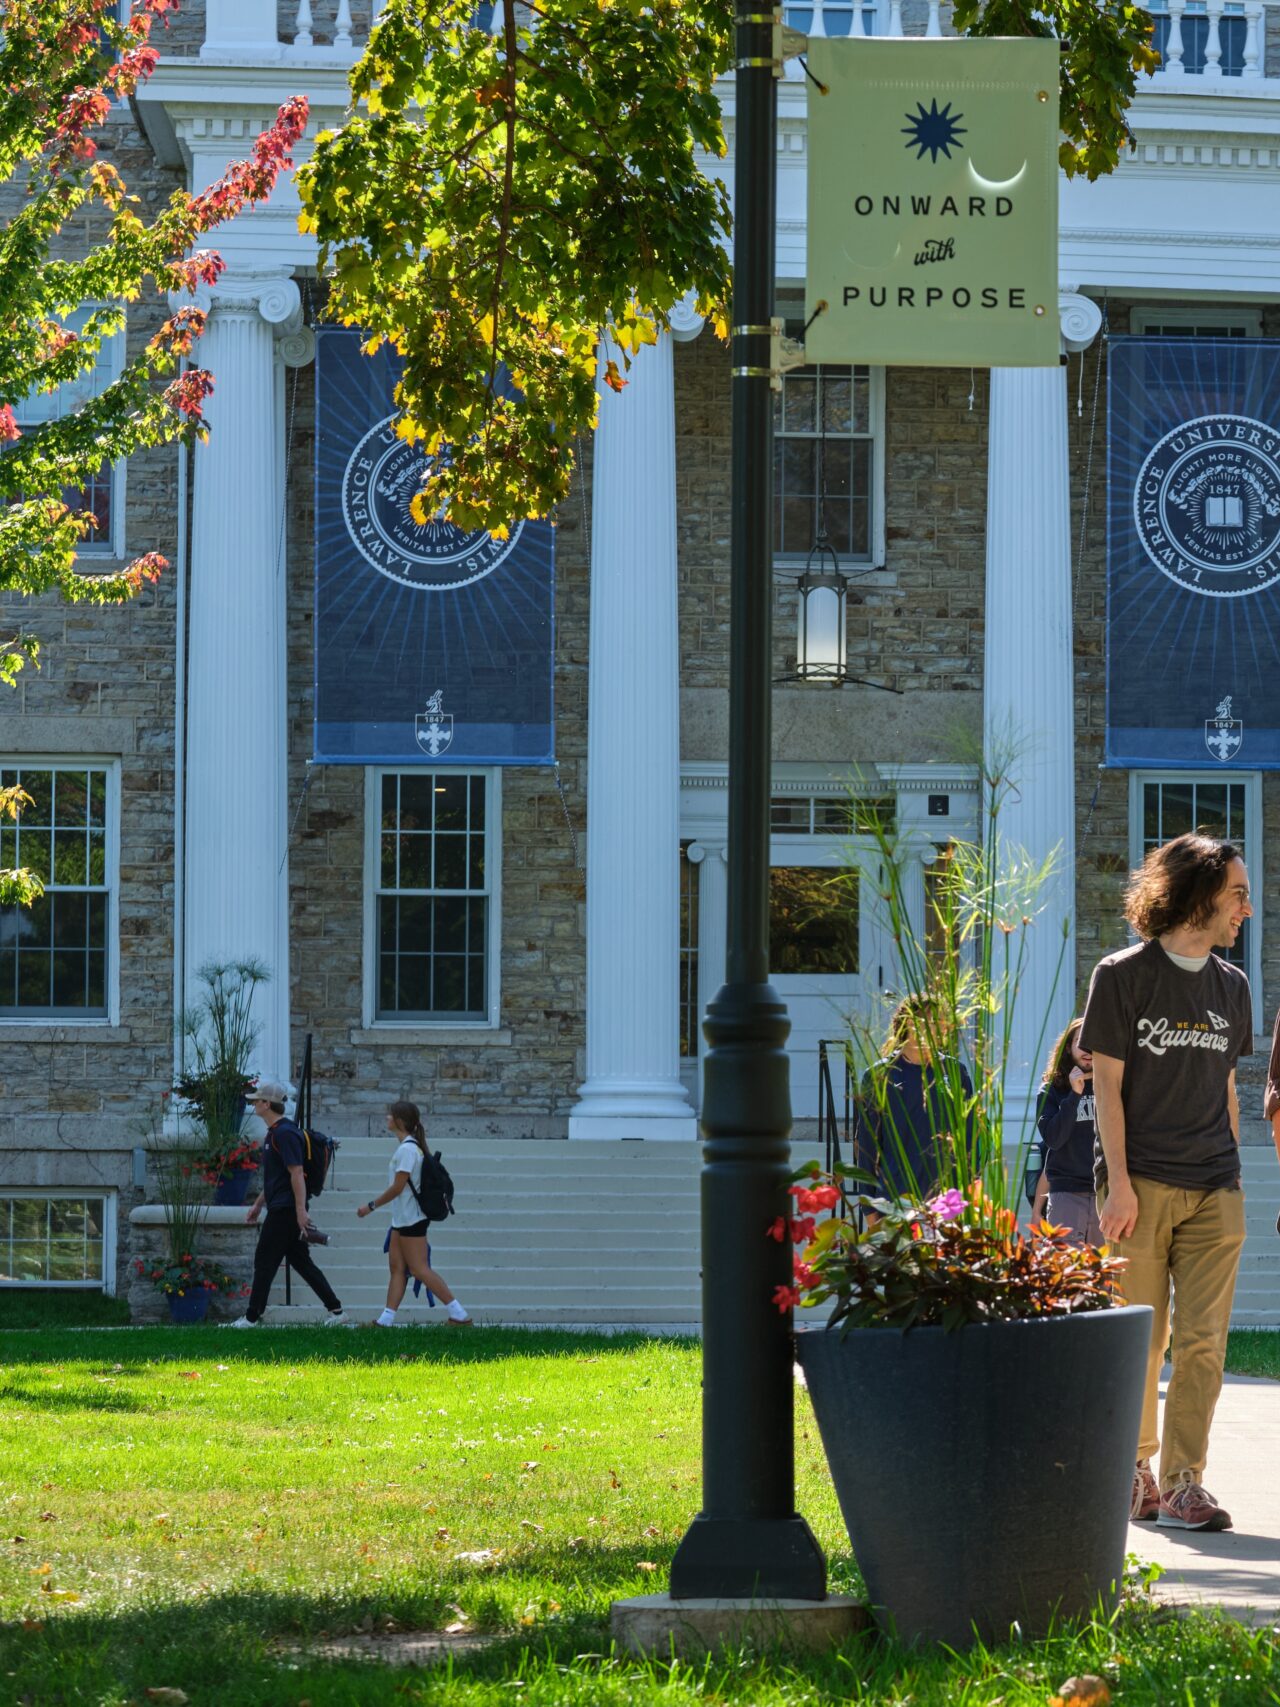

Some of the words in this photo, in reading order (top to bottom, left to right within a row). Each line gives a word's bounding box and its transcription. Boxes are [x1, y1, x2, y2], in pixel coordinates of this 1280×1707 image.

[854, 195, 1014, 217] ONWARD
[913, 237, 956, 266] with
[843, 286, 1026, 309] PURPOSE
[1208, 453, 1242, 463] MORE
[1209, 484, 1240, 495] 1847
[352, 457, 413, 576] LAWRENCE
[1144, 466, 1203, 583] LAWRENCE
[394, 525, 431, 553] VERITAS
[436, 543, 455, 553] EST
[1183, 533, 1221, 560] VERITAS
[1226, 551, 1245, 561] EST
[1193, 1023, 1209, 1031] ARE
